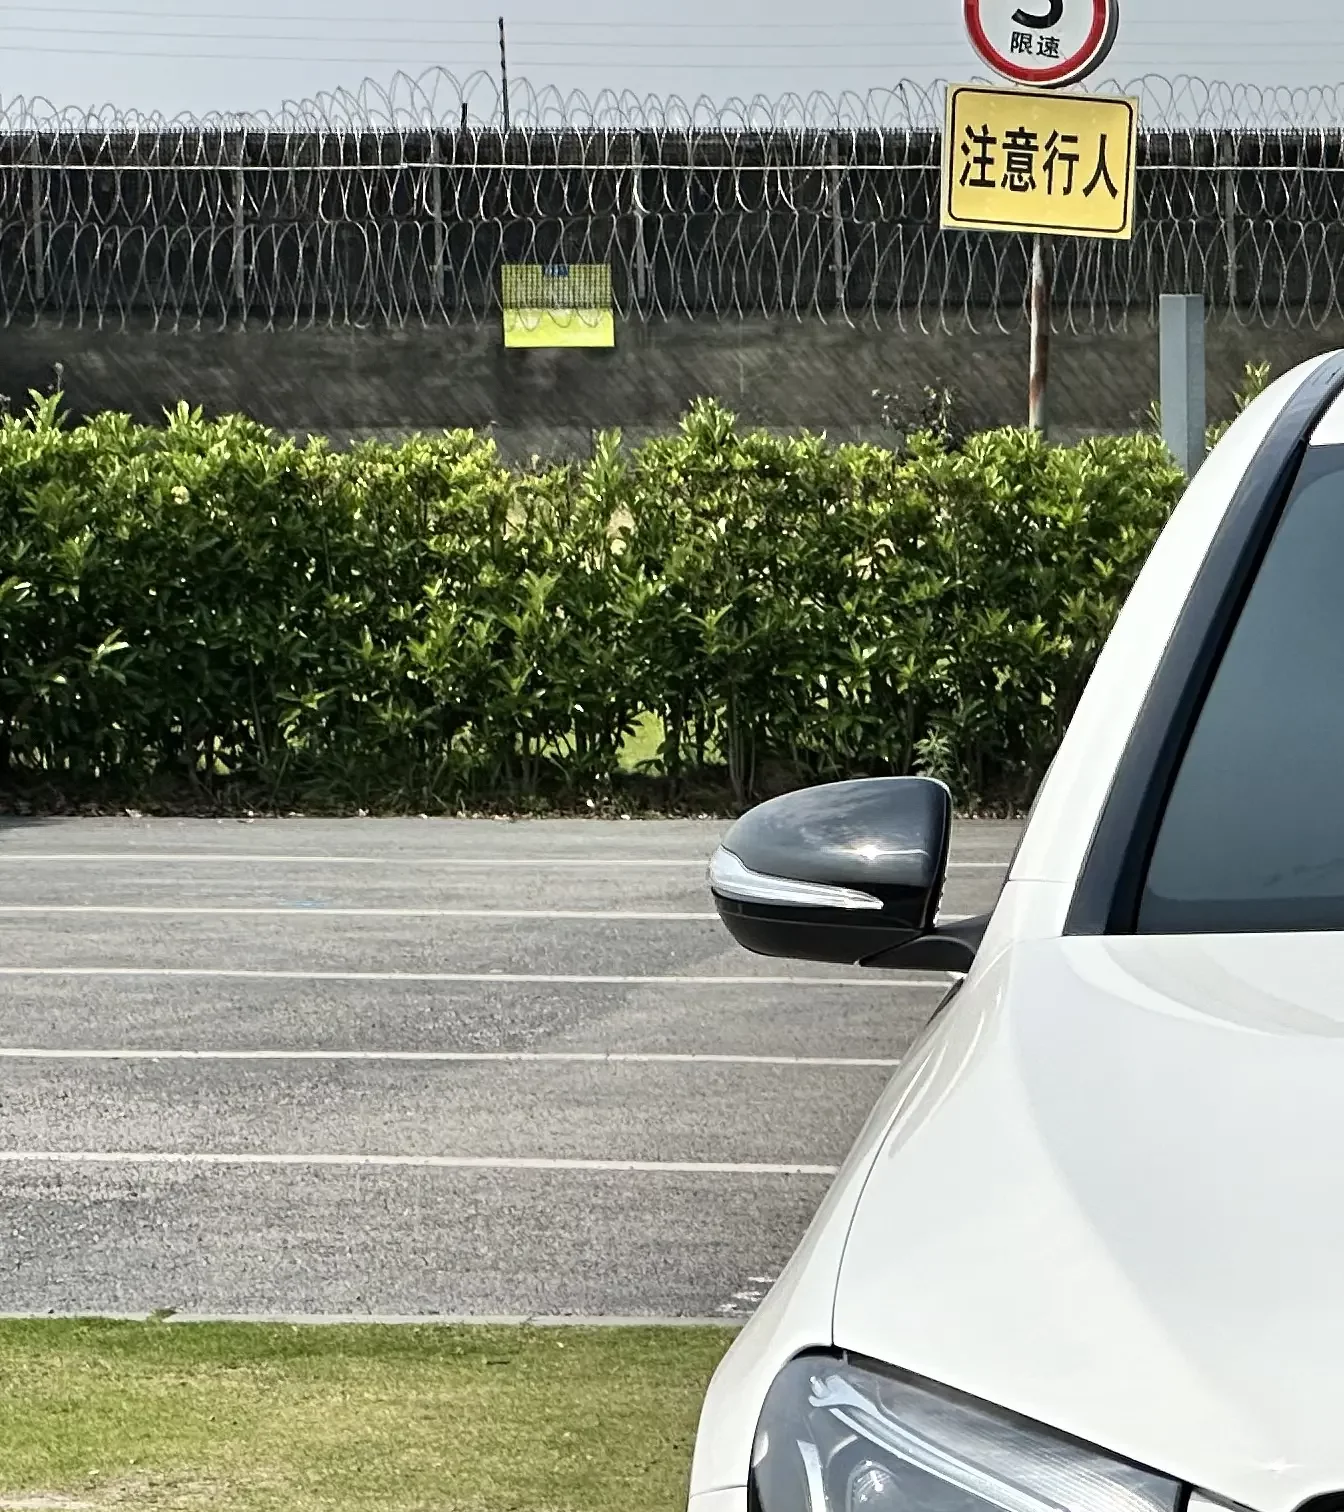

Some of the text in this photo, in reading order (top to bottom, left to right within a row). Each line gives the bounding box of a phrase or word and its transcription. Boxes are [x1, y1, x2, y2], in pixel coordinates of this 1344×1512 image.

[1010, 31, 1061, 59] 限速
[958, 123, 1119, 200] 注意行人
